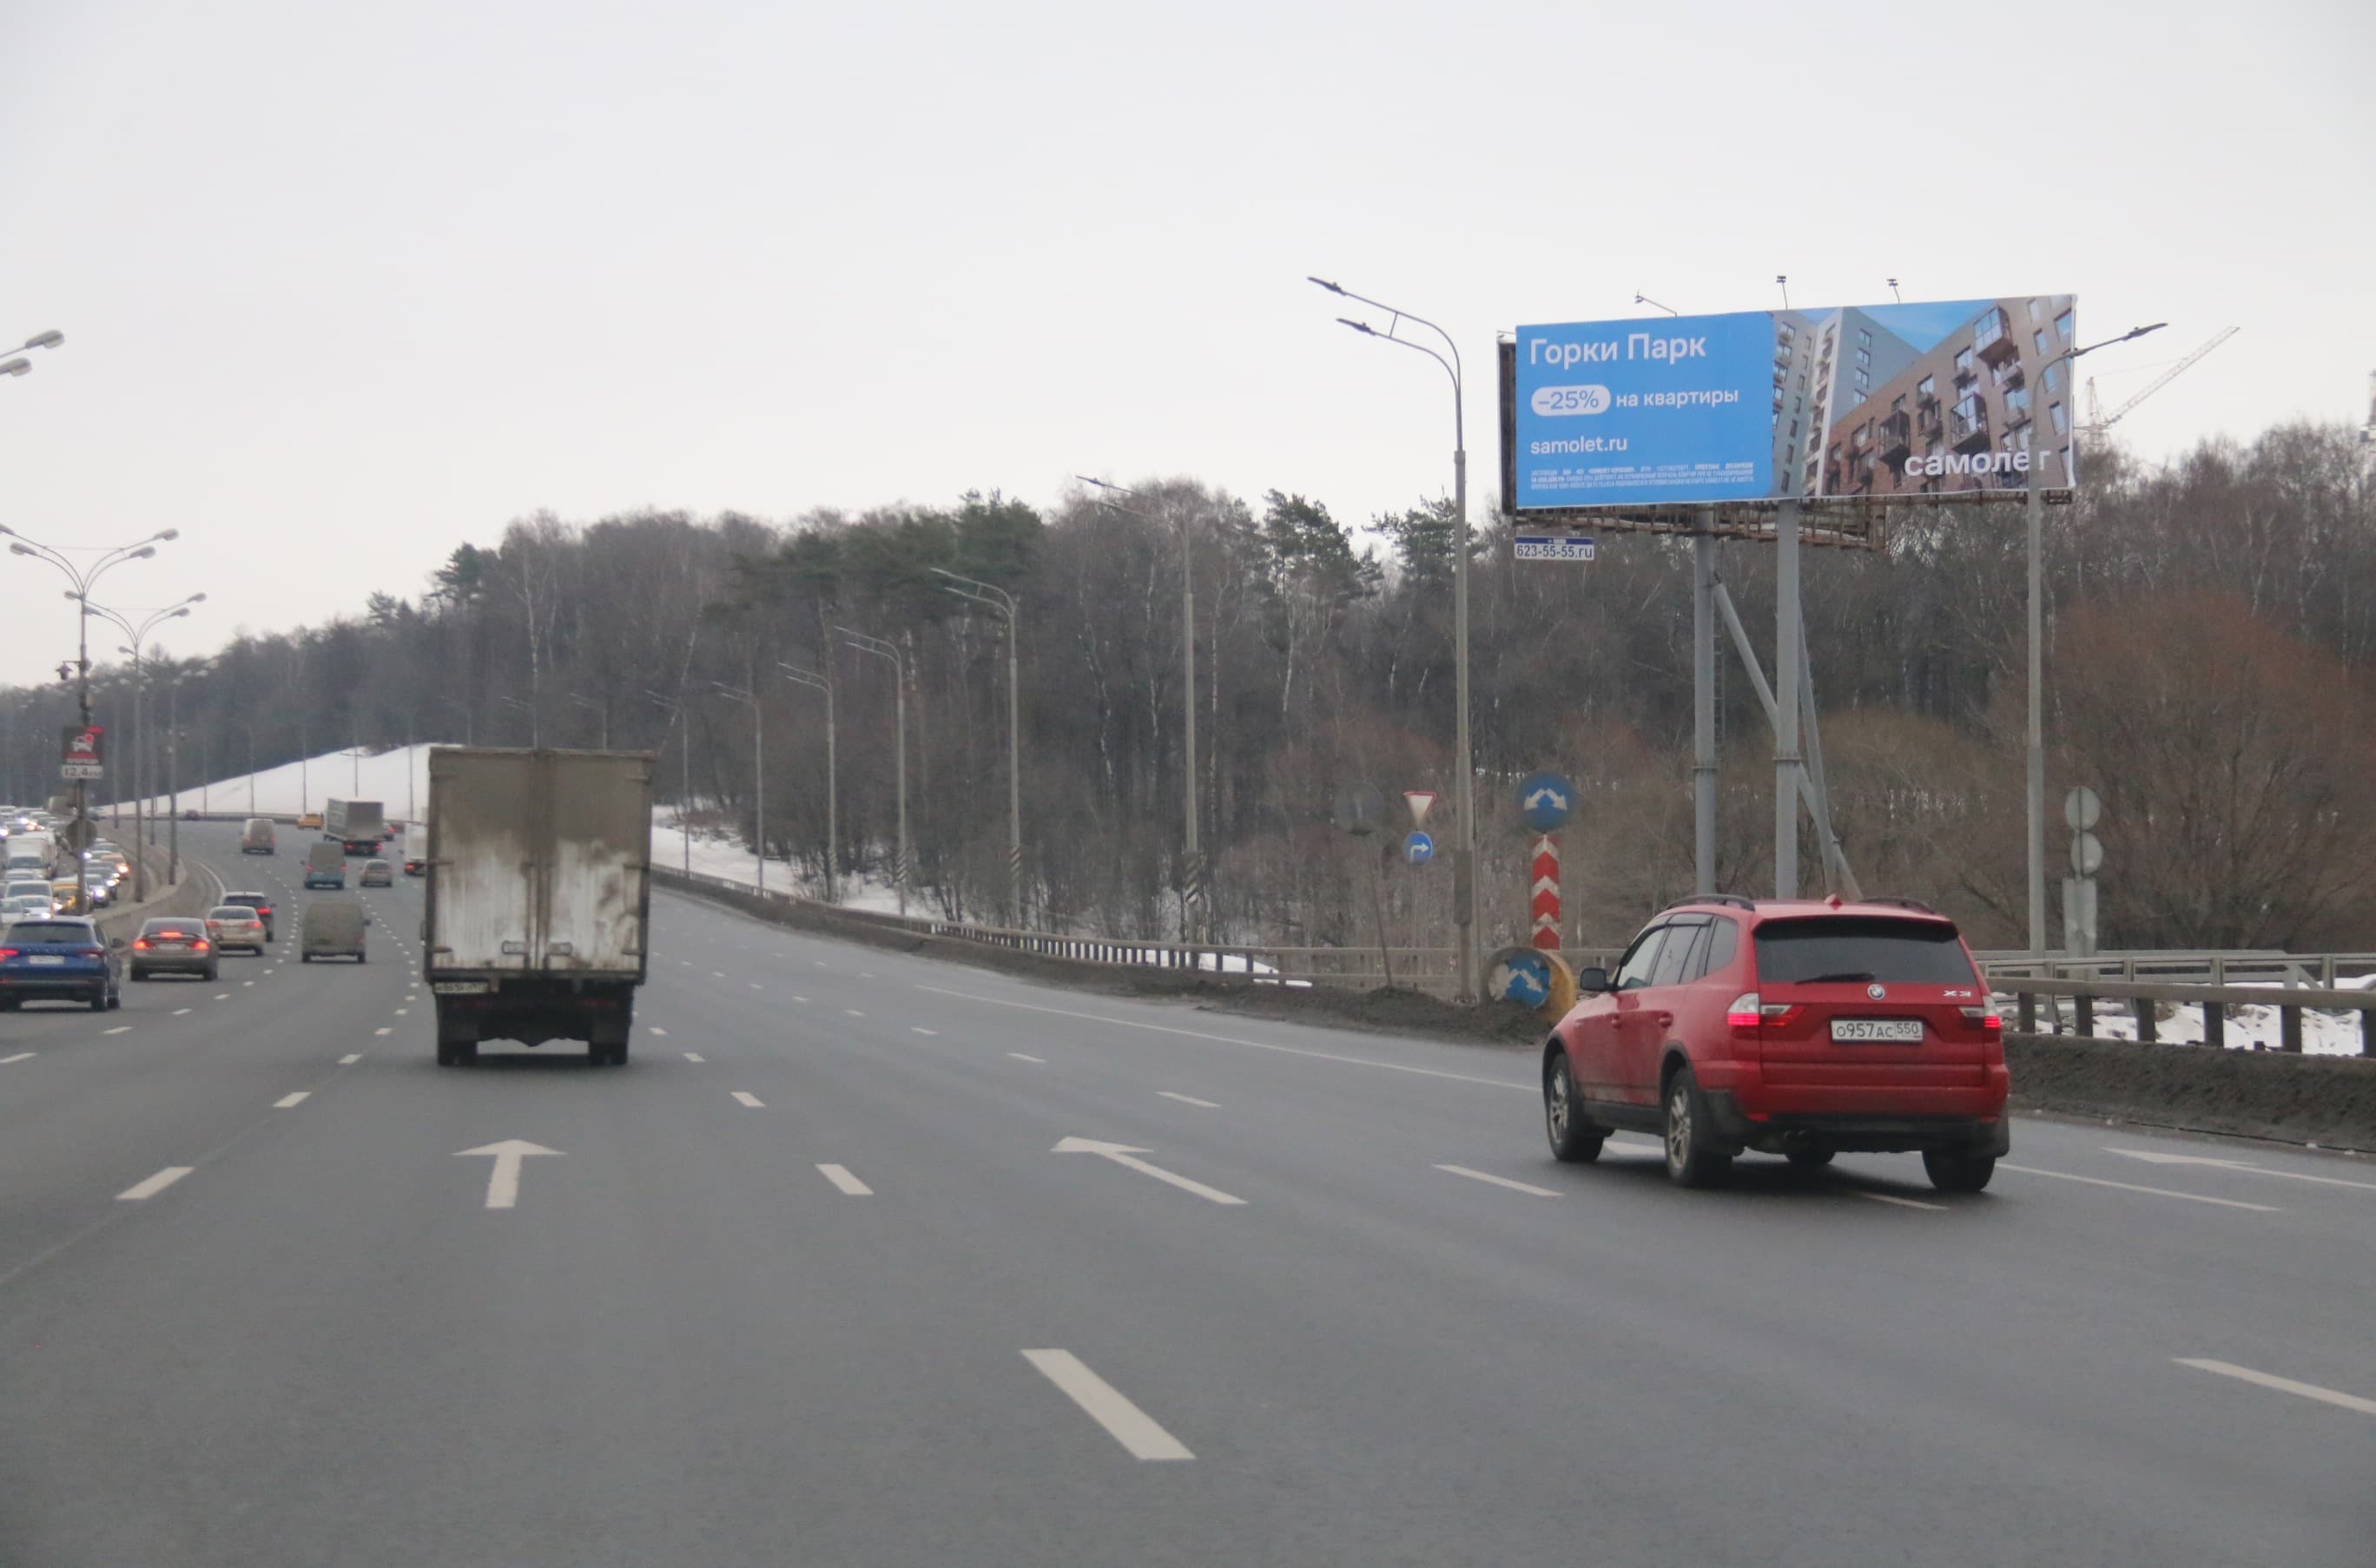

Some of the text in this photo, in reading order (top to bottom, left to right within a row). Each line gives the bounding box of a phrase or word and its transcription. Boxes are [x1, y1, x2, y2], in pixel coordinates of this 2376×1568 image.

[1530, 333, 1706, 370] Горки Парк
[1616, 389, 1739, 409] на квартиры
[1530, 435, 1627, 455] samolet.ru
[1516, 544, 1593, 558] 623-55-55.ru
